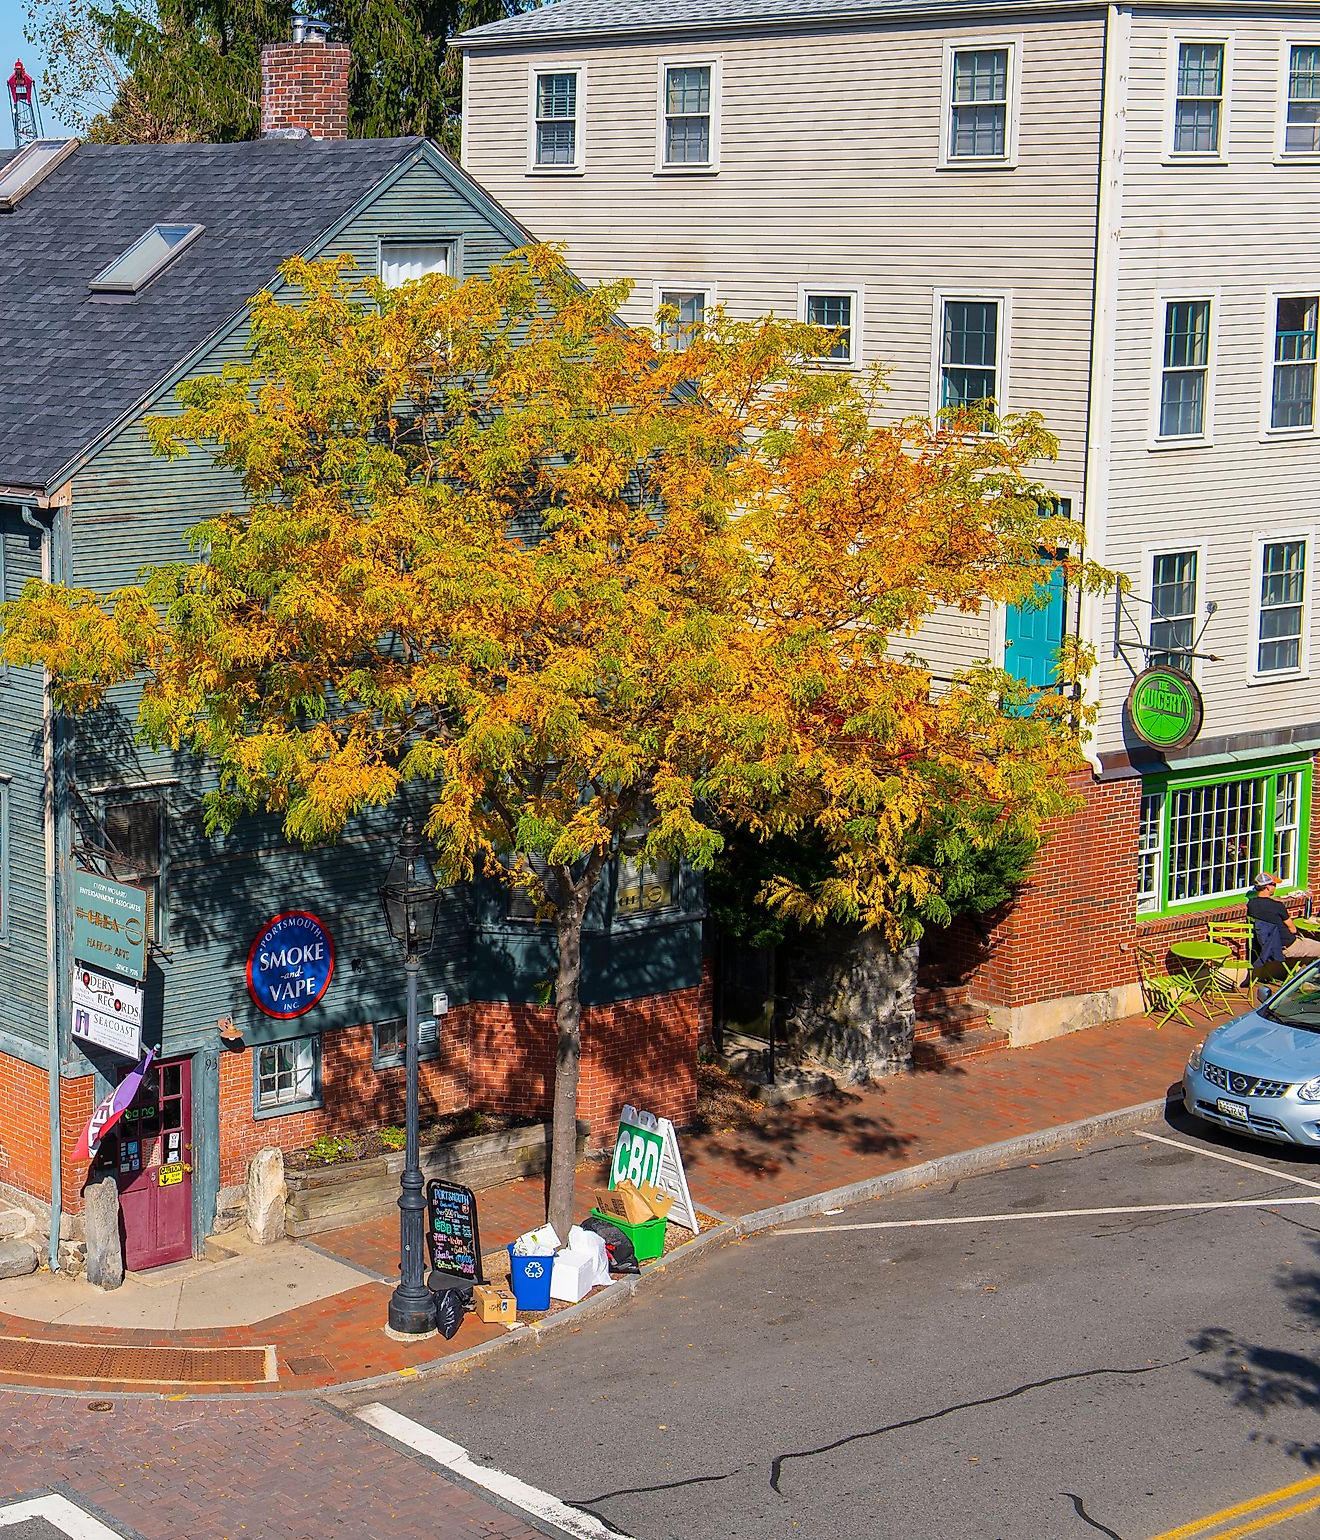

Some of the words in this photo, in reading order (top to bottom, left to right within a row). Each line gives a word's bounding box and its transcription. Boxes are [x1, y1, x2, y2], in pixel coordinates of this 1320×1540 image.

[1158, 681, 1169, 691] THE
[1141, 688, 1184, 714] JUICERY
[261, 917, 321, 948] PORTSMOUTH
[260, 942, 324, 971] SMOKE
[75, 970, 114, 992] MODERN
[269, 977, 316, 1002] VAPE
[97, 993, 139, 1017] RECORDS
[93, 1013, 135, 1038] SEACOAST
[205, 1058, 217, 1070] 93
[160, 1164, 181, 1176] CAUTION
[613, 1130, 659, 1189] CBD
[434, 1218, 452, 1234] CBD
